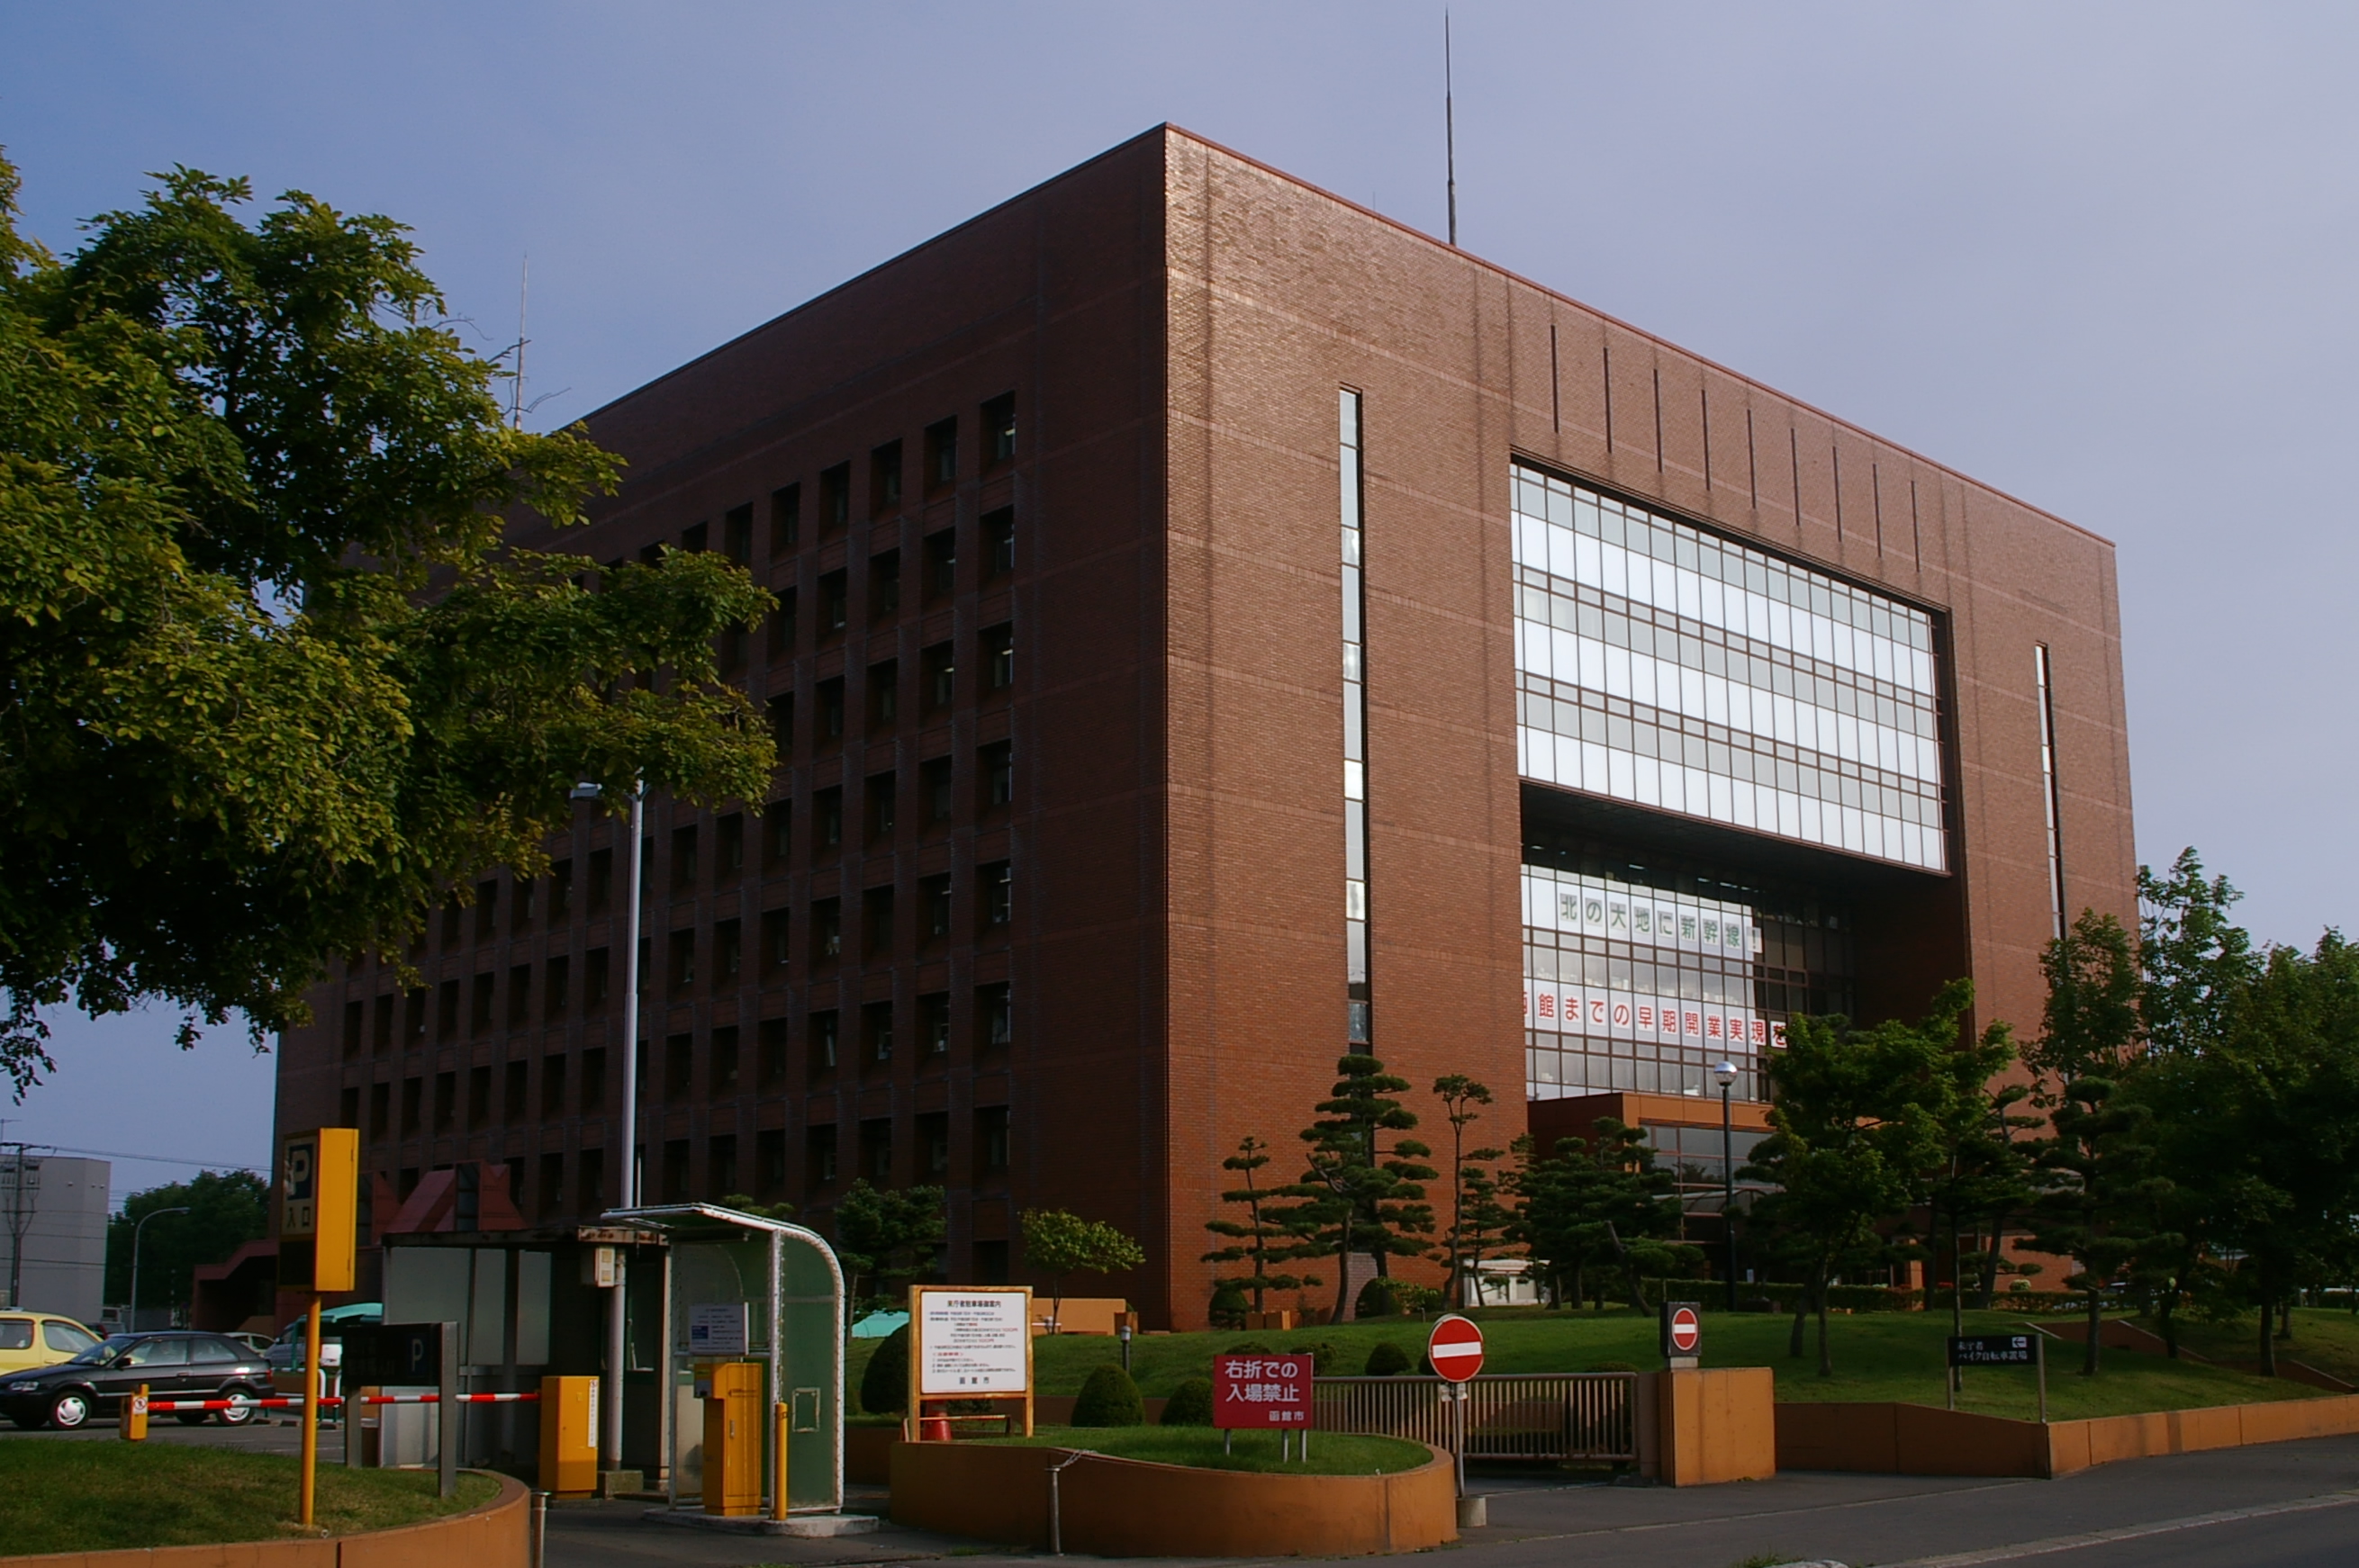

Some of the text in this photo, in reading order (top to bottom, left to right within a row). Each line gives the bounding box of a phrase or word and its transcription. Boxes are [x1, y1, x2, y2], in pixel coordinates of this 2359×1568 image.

[1523, 991, 1786, 1046] 館までの早期開業実現を
[287, 1149, 311, 1196] P
[286, 1207, 312, 1229] 入口
[411, 1338, 425, 1373] P
[1957, 1341, 1984, 1350] 来庁者
[1958, 1350, 2028, 1361] バイク自転車置場
[1225, 1359, 1298, 1379] 右折での
[1225, 1383, 1300, 1402] 入場禁止
[1269, 1410, 1305, 1421] 函館市
